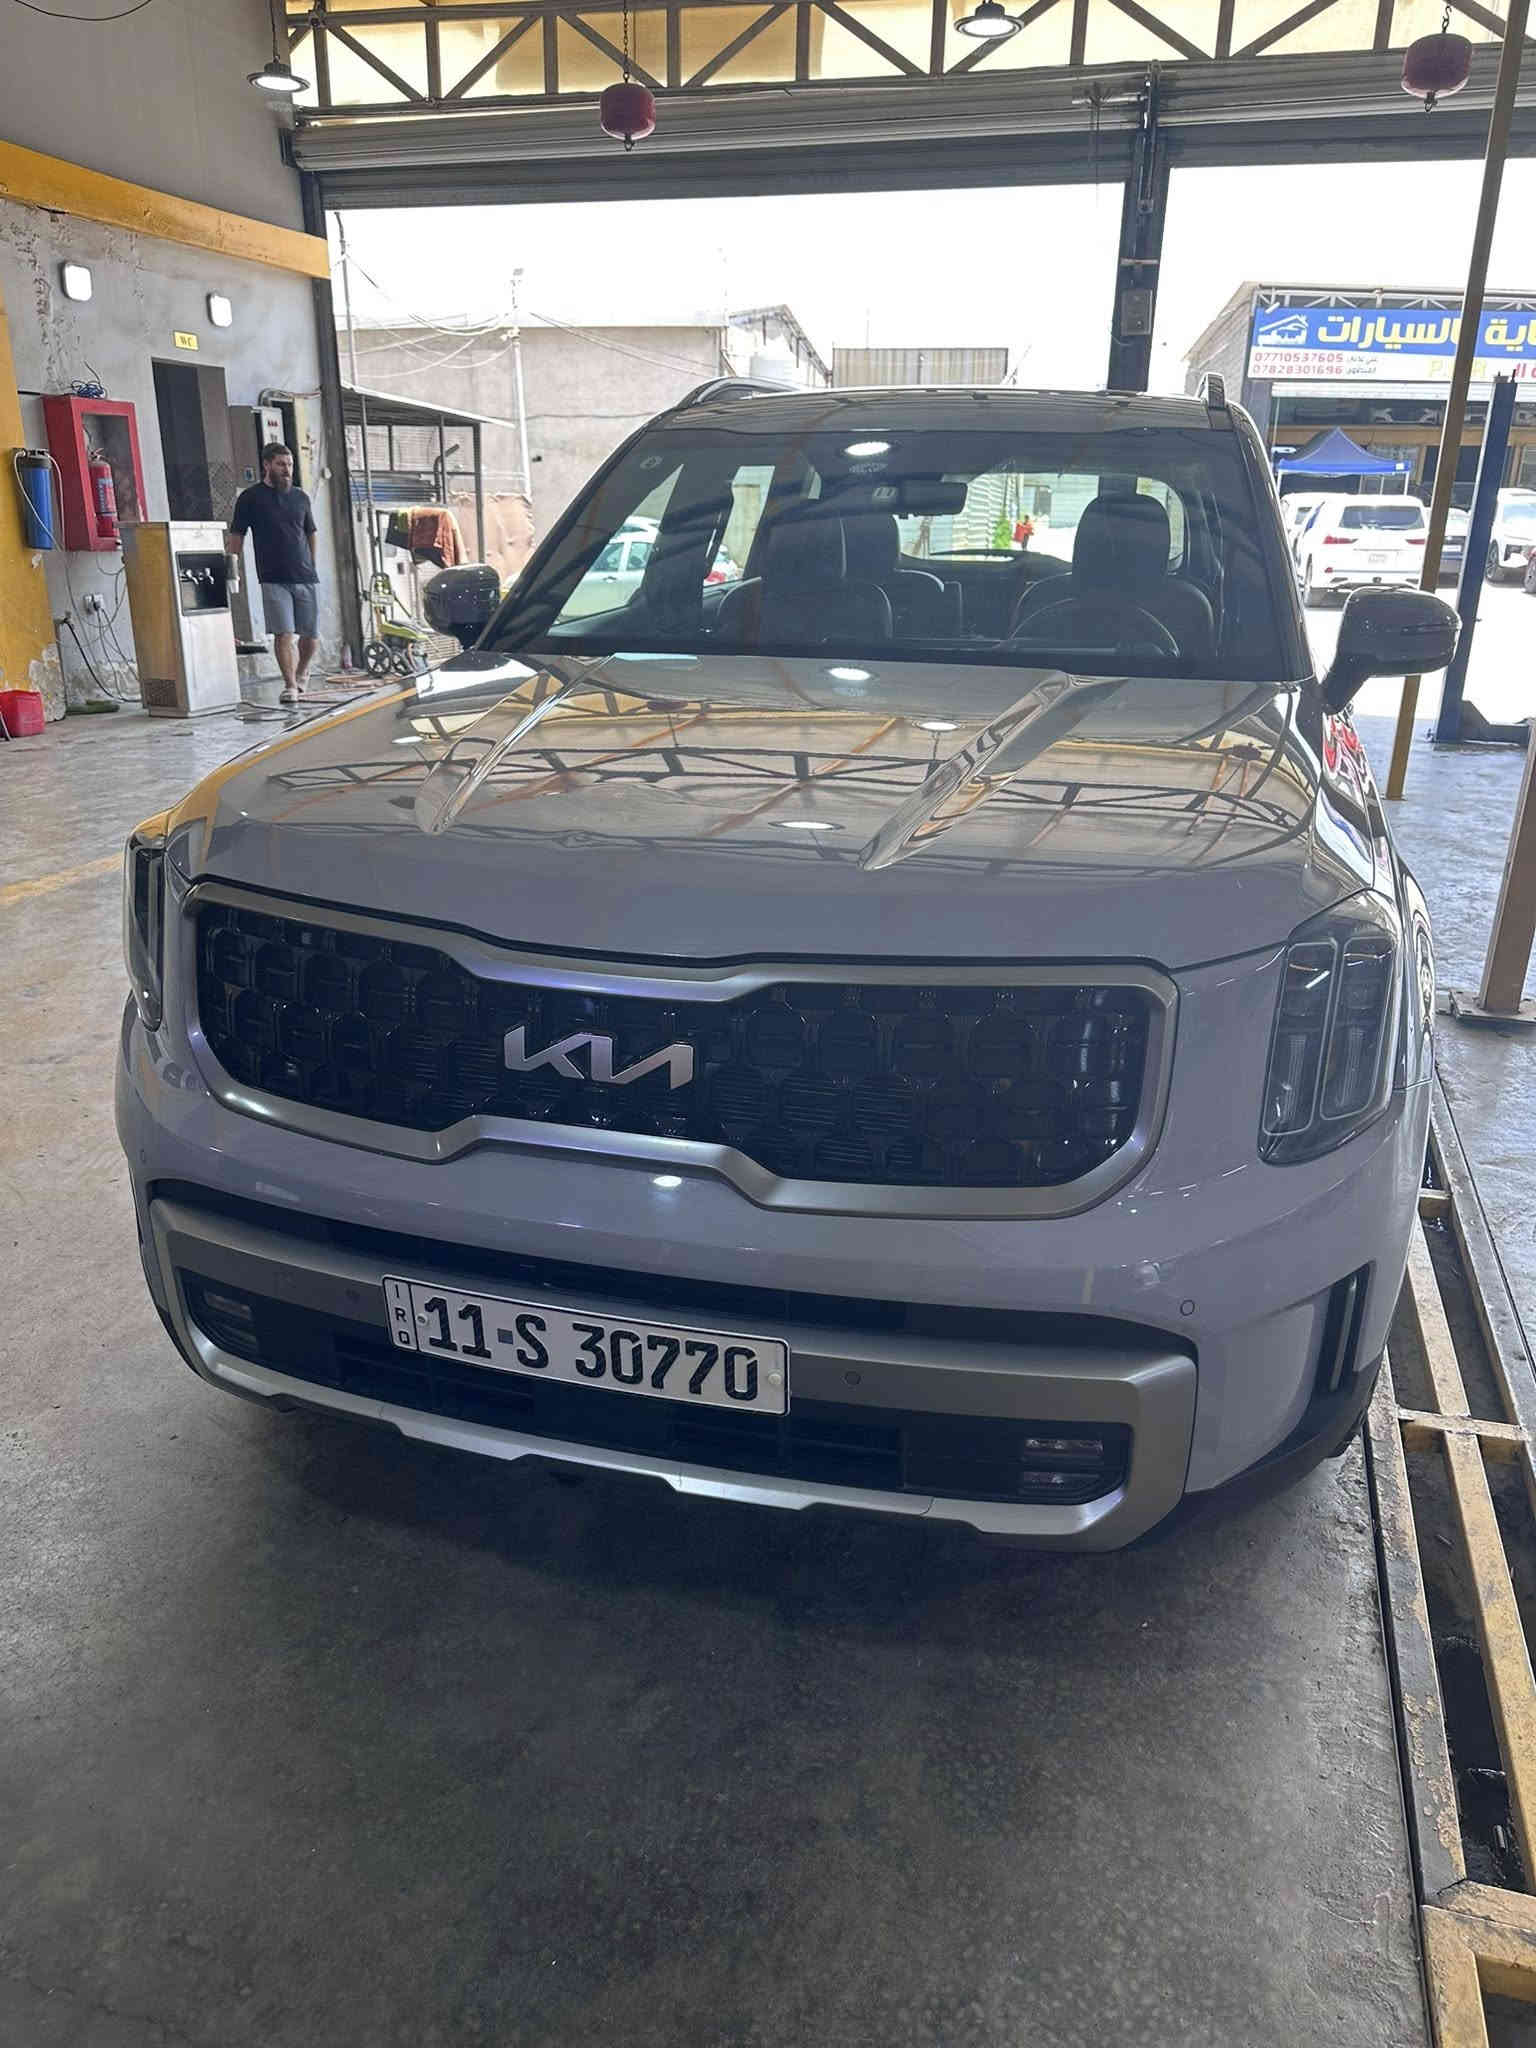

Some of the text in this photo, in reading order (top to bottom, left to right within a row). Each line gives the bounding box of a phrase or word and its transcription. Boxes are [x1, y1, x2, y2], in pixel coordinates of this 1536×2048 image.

[1254, 352, 1343, 362] 07710537605
[1318, 316, 1462, 350] السيارات
[504, 1026, 693, 1090] KIA
[572, 1323, 758, 1400] 30770
